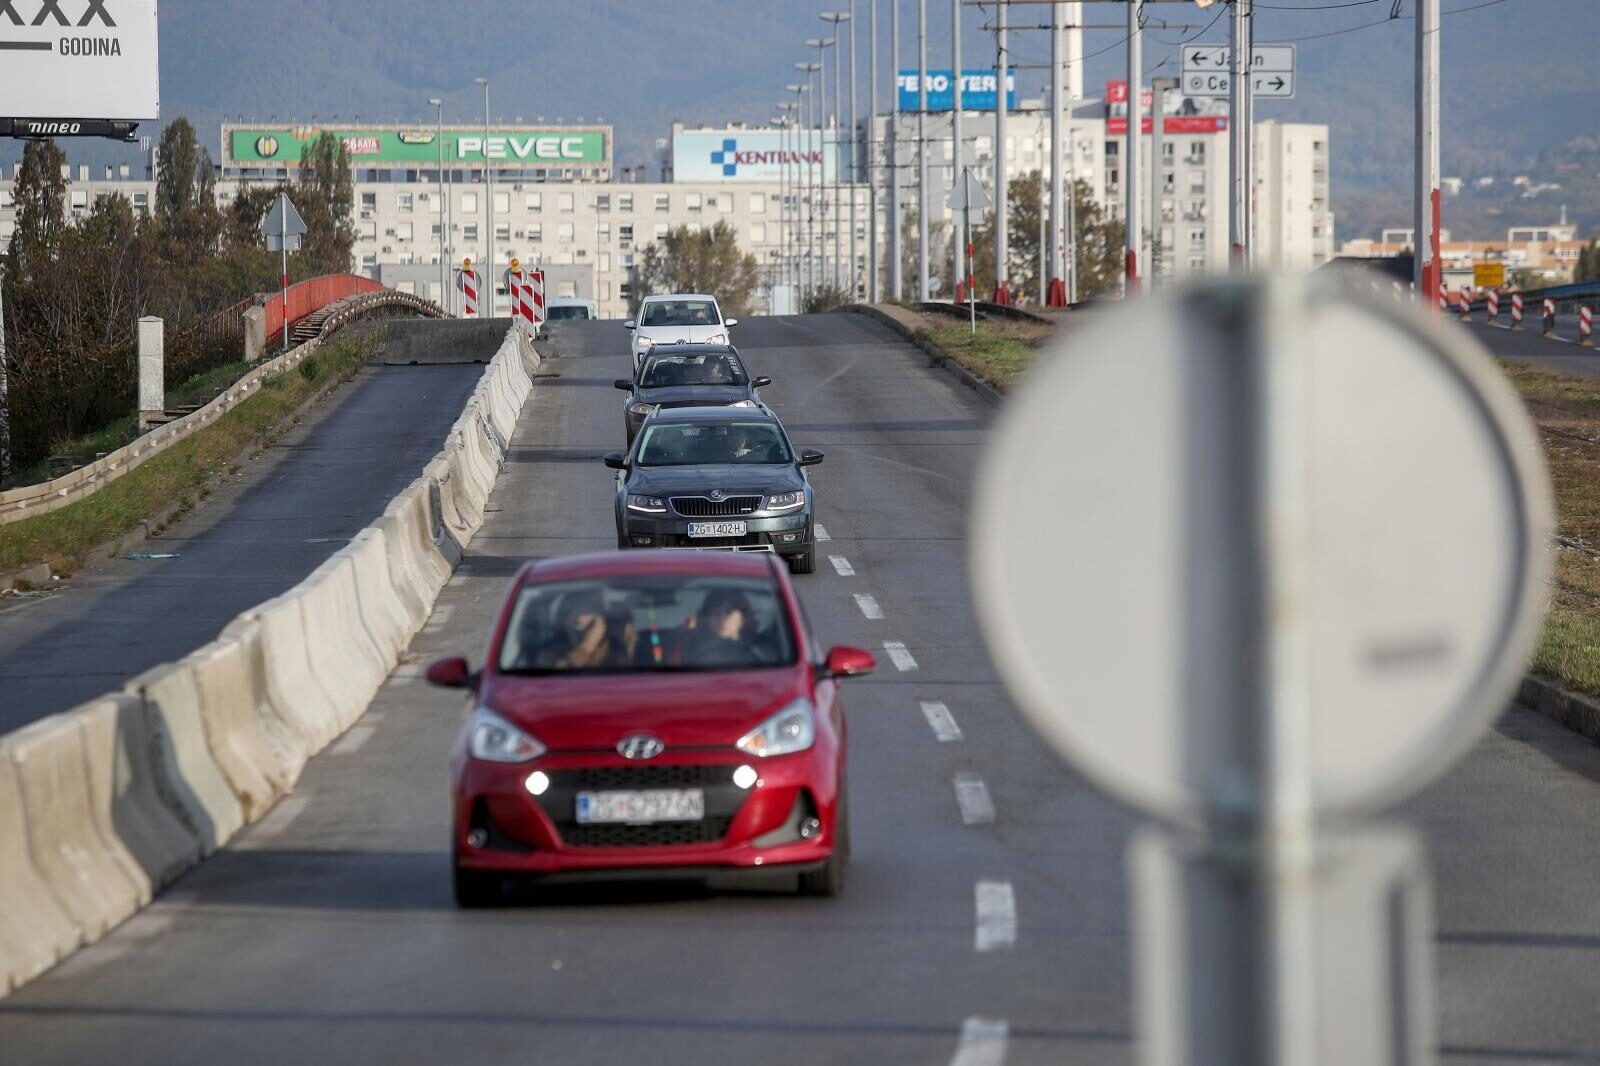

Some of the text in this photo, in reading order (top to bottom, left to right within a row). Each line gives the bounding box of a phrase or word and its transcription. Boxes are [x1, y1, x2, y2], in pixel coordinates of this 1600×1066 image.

[59, 37, 121, 56] GODINA
[28, 122, 81, 134] mineo
[457, 137, 583, 158] PEVEC
[694, 524, 706, 535] ZG
